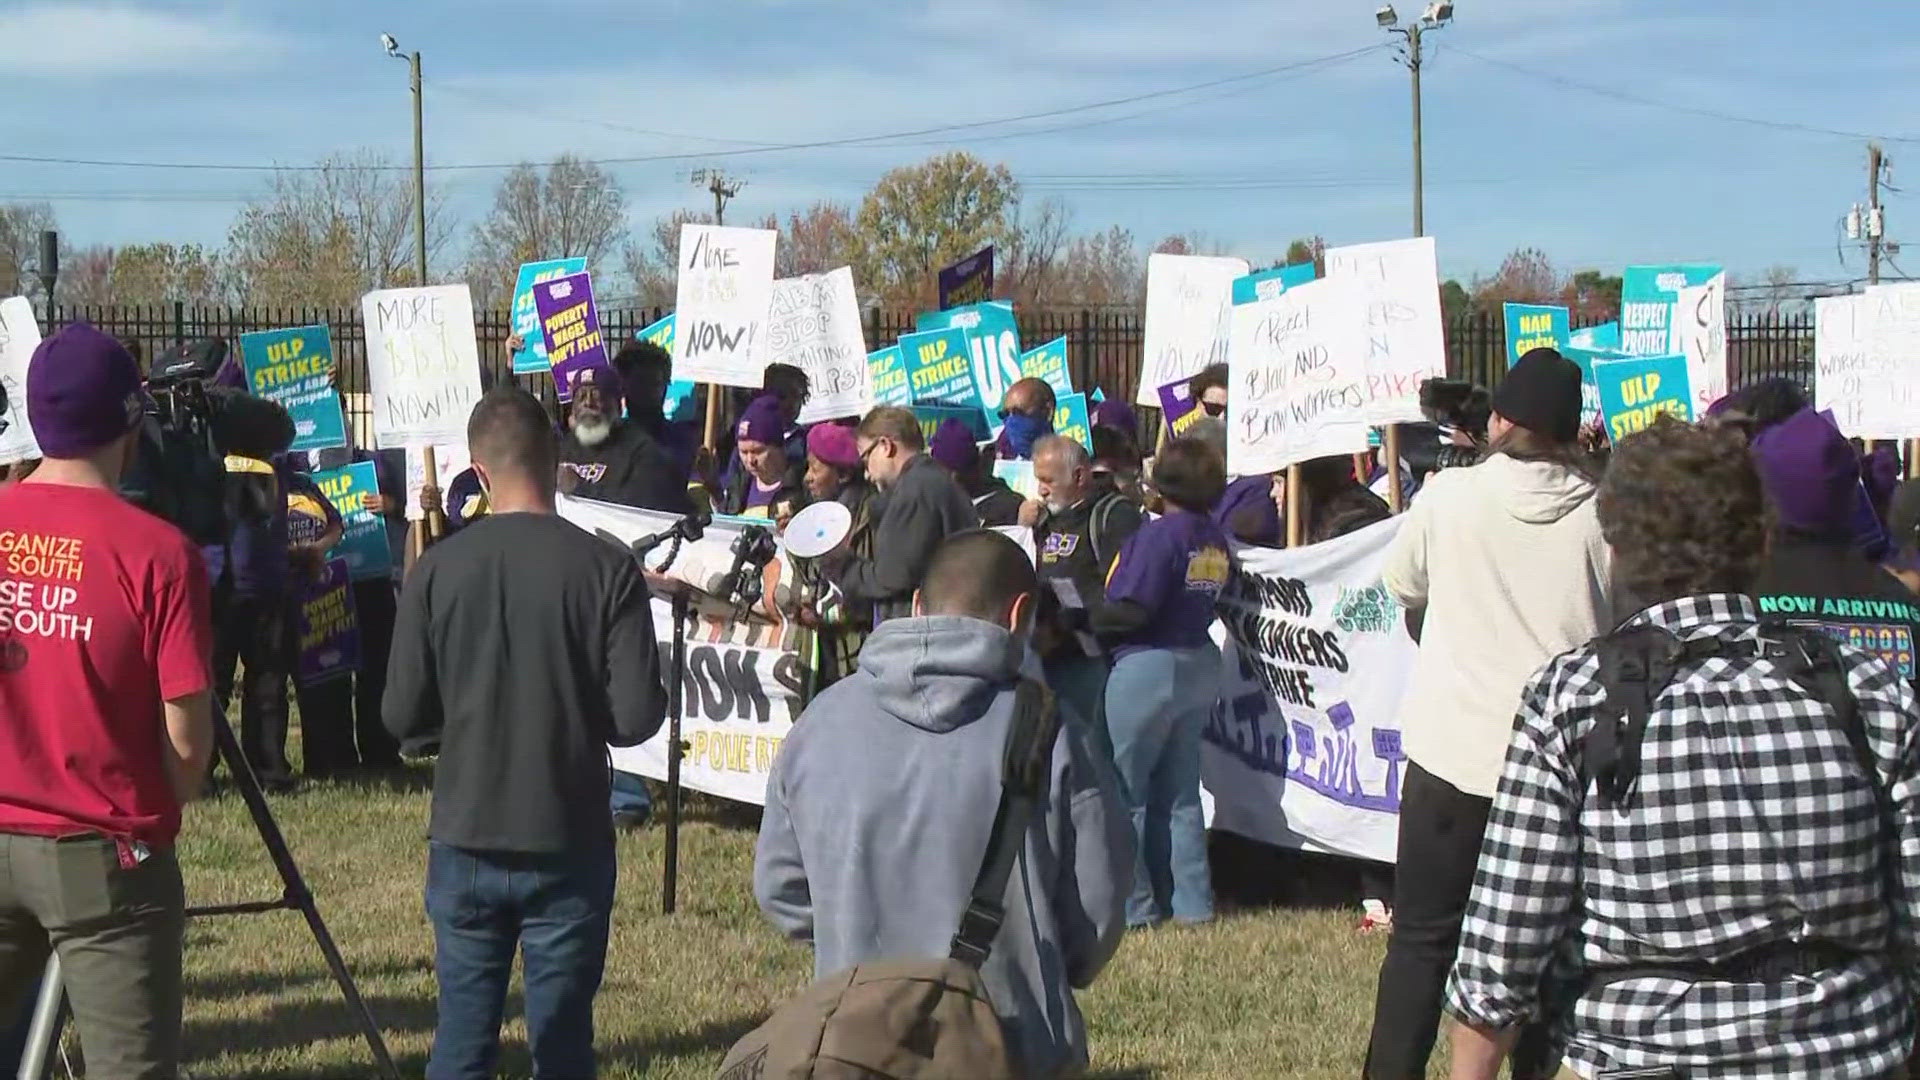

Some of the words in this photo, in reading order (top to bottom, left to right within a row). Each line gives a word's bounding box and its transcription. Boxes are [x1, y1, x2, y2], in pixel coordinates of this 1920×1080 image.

[377, 295, 445, 332] MORE
[545, 301, 588, 335] POVERTY
[1623, 302, 1668, 329] RESPECT
[552, 319, 587, 349] WAGES
[686, 321, 758, 360] NOW!
[769, 311, 831, 350] STOP
[1622, 329, 1668, 355] PROTECT
[266, 338, 304, 363] ULP
[548, 341, 576, 368] DON'T
[577, 330, 600, 354] FLY!
[918, 339, 948, 365] ULP
[255, 355, 328, 390] STRIKE:
[911, 354, 969, 390] STRIKE:
[970, 330, 1022, 409] US
[1620, 373, 1661, 407] ULP
[1054, 406, 1071, 429] LP
[0, 531, 82, 560] GANIZE
[7, 553, 83, 581] SOUTH
[0, 580, 34, 608] SE
[42, 585, 77, 611] UP
[1759, 595, 1816, 613] NOW
[1822, 598, 1920, 623] ARRIVING
[0, 607, 93, 641] SOUTH
